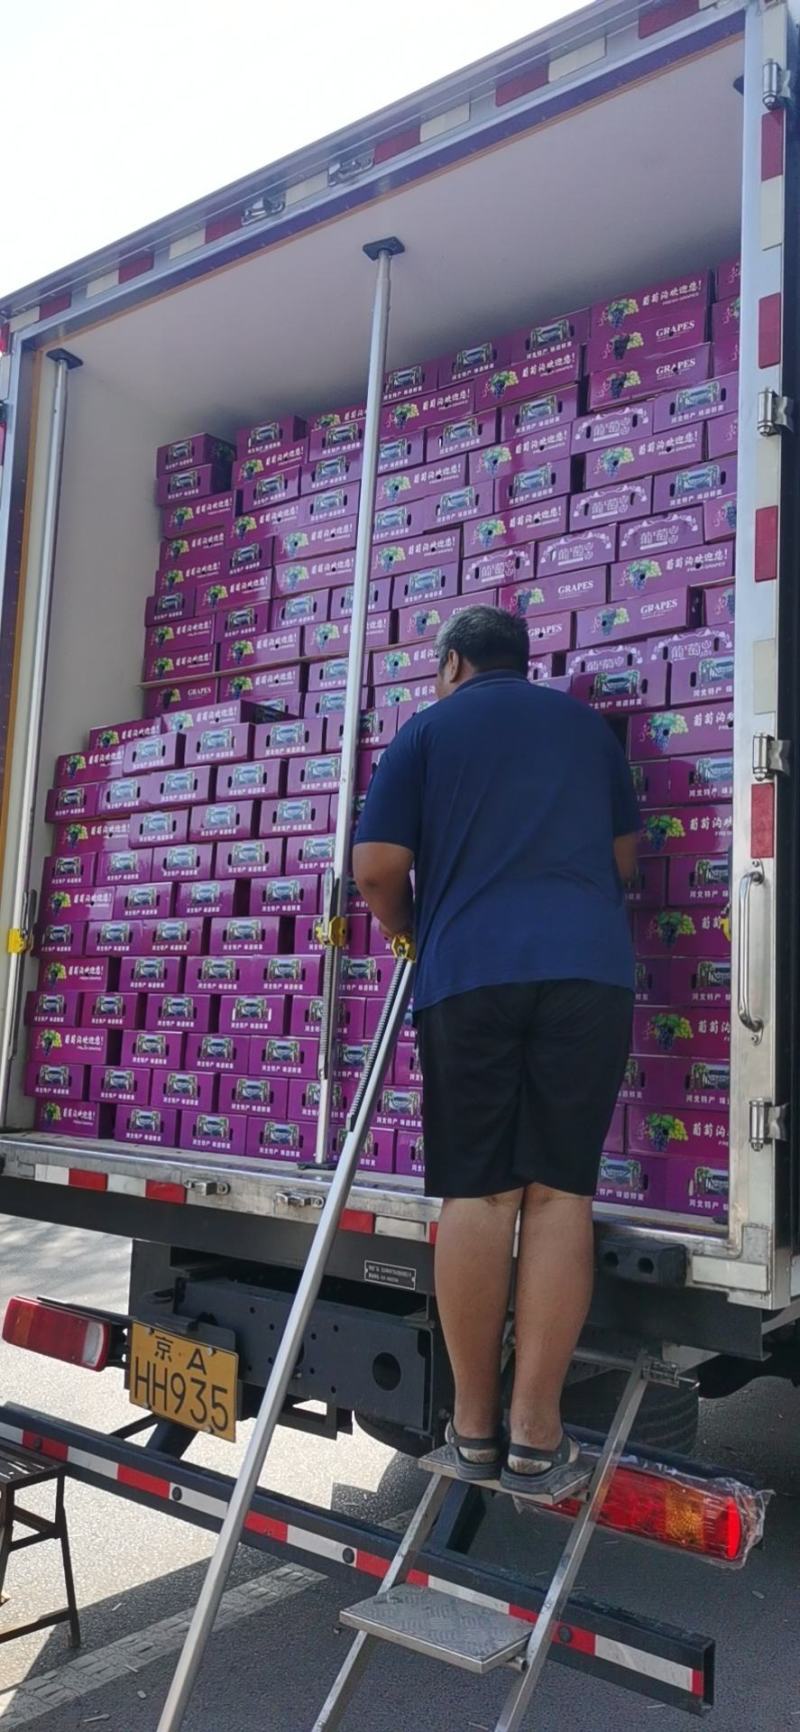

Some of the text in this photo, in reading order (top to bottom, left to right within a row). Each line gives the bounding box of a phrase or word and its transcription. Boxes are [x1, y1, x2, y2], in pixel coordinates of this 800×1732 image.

[656, 321, 695, 337] GRAPES
[656, 359, 696, 375] GRAPES
[558, 581, 593, 593] GRAPES
[641, 599, 678, 615] GRAPES
[528, 623, 562, 637] GRAPES
[135, 1356, 228, 1432] HH935
